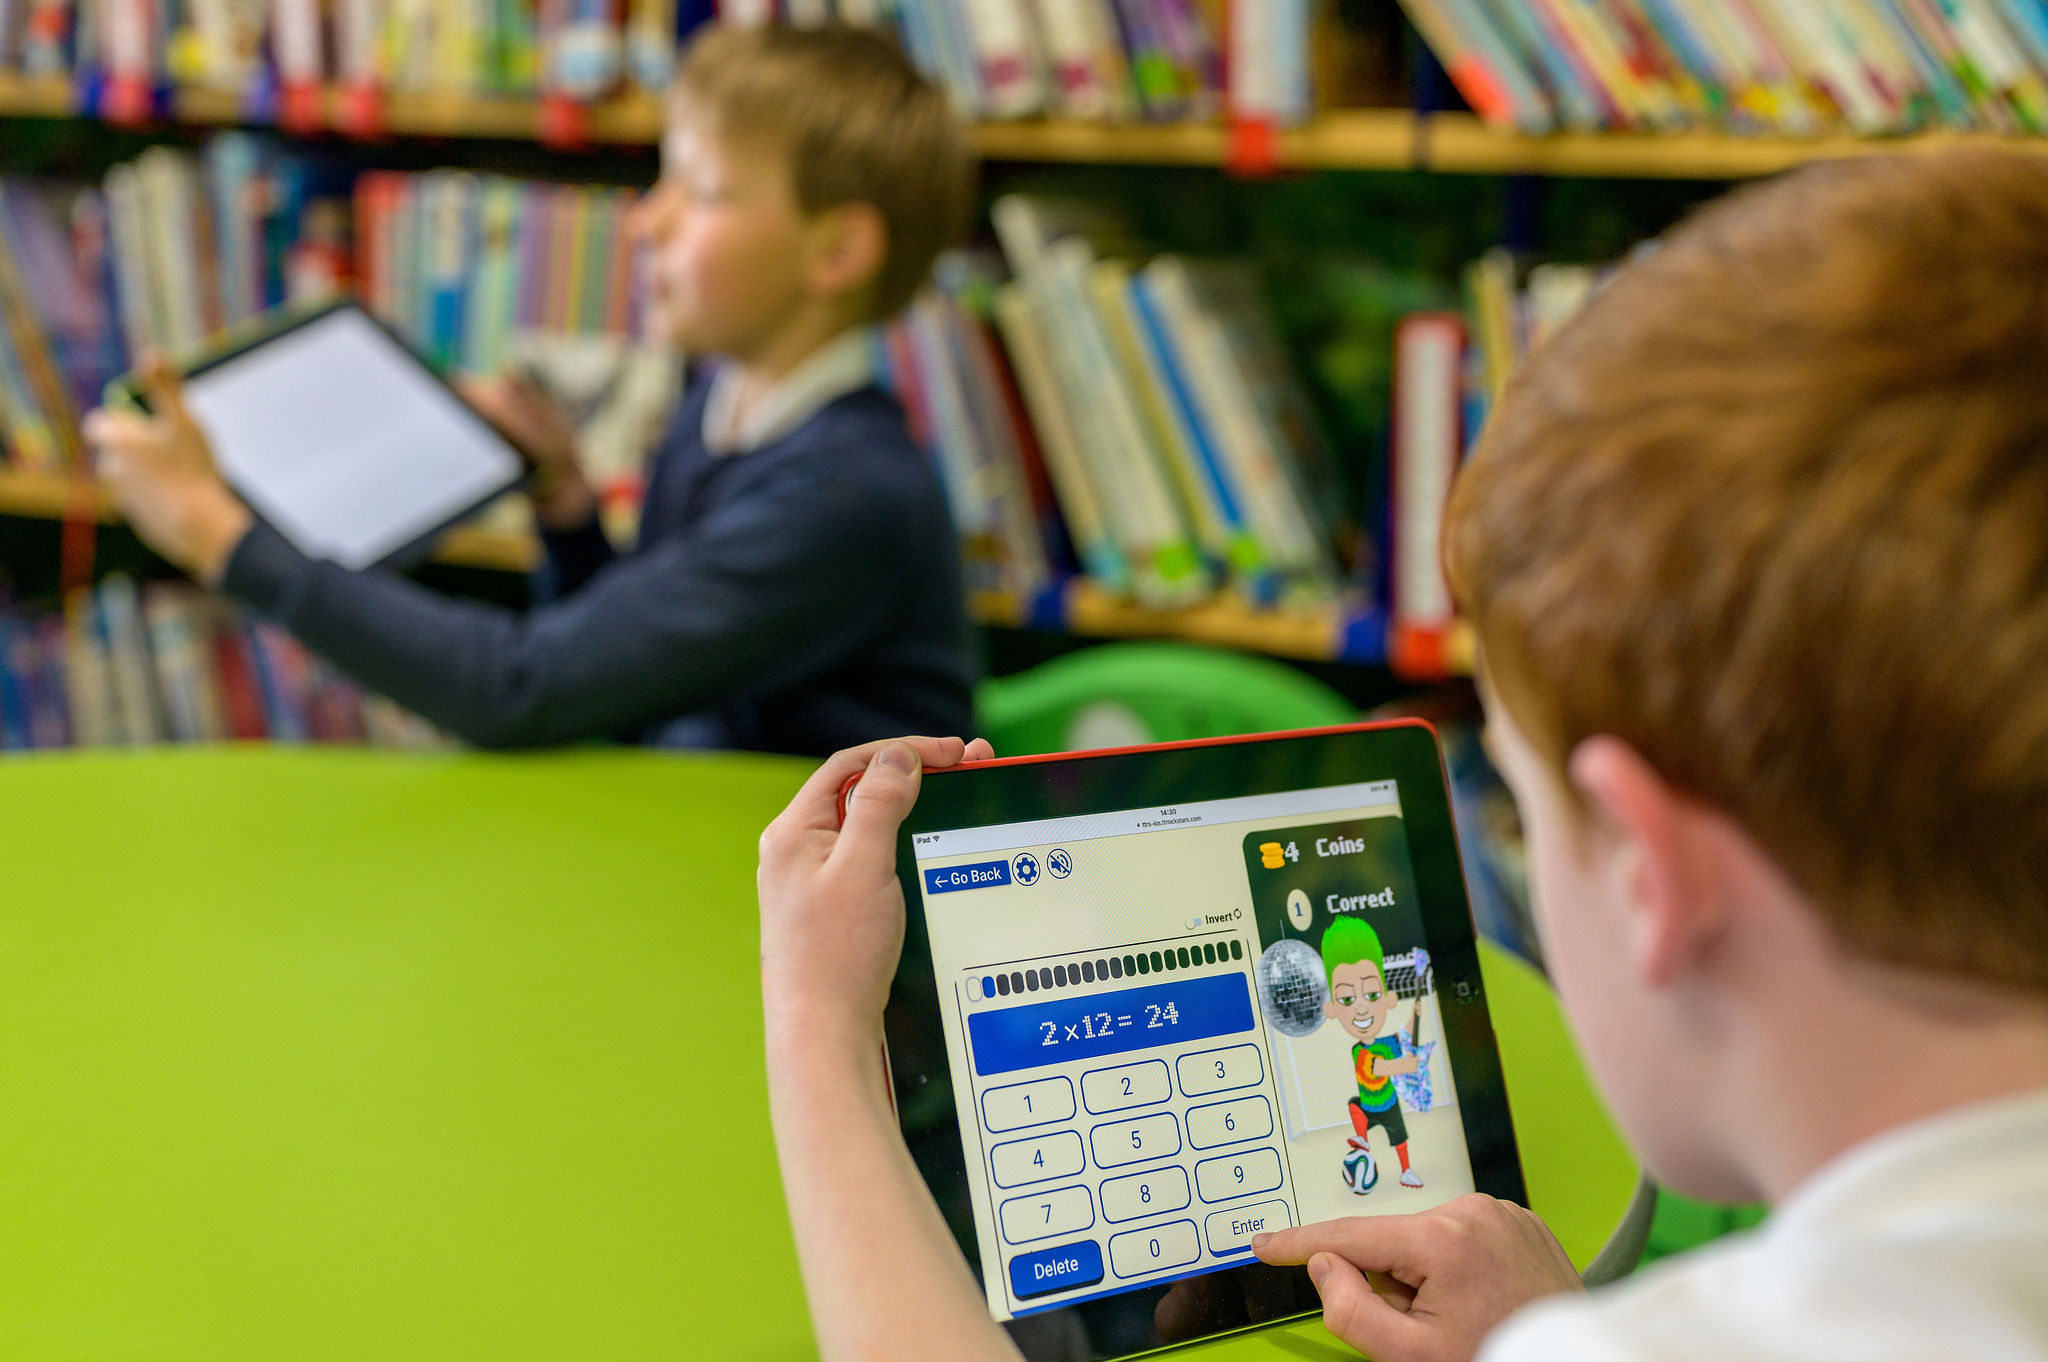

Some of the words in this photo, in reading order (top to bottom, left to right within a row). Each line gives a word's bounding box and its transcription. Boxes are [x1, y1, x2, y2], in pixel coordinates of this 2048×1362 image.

[1160, 808, 1177, 816] 14:30
[1284, 841, 1300, 863] 4
[1315, 836, 1366, 858] Coins
[951, 872, 969, 885] Go
[971, 867, 1002, 883] Back
[1294, 902, 1304, 917] 1
[1326, 887, 1396, 914] Correct
[1205, 911, 1234, 925] Invert
[1144, 1001, 1179, 1029] 24
[1214, 1060, 1226, 1079] 3
[1121, 1077, 1134, 1096] 2
[1023, 1094, 1033, 1113] 1
[1225, 1112, 1236, 1131] 6
[1131, 1130, 1142, 1149] 5
[1033, 1149, 1045, 1168] 4
[1233, 1165, 1244, 1184] 9
[1140, 1184, 1151, 1203] 8
[1040, 1204, 1052, 1224] 7
[1231, 1215, 1265, 1236] Enter
[1149, 1239, 1161, 1258] 0
[1034, 1257, 1079, 1280] Delete
